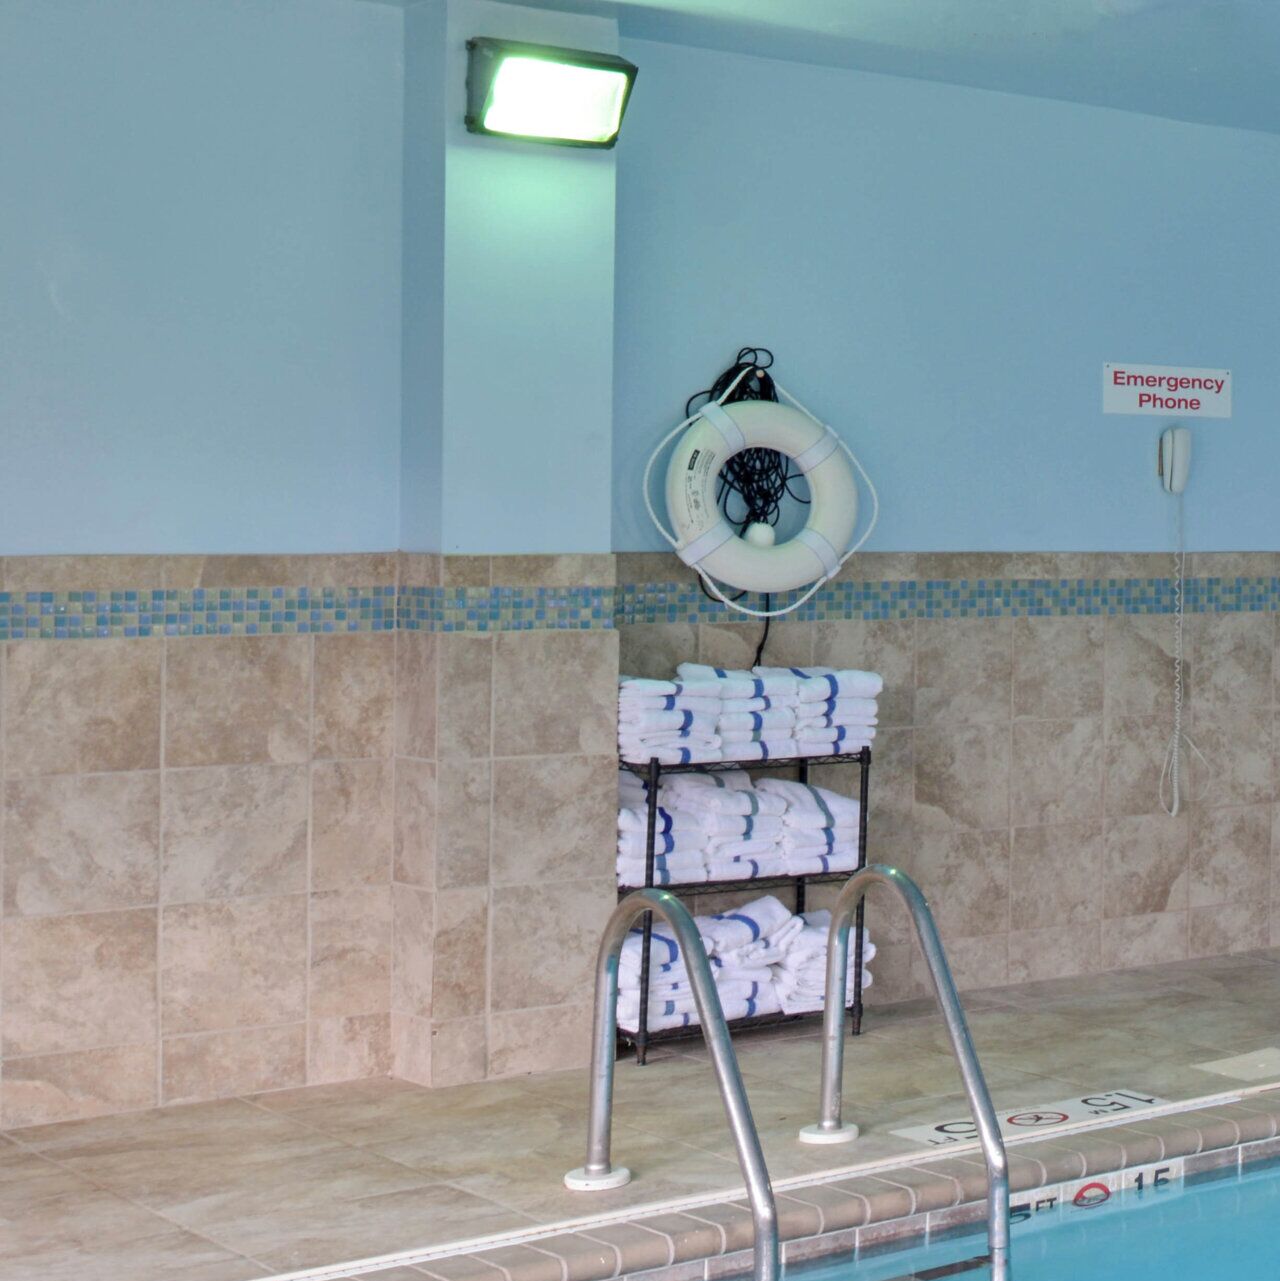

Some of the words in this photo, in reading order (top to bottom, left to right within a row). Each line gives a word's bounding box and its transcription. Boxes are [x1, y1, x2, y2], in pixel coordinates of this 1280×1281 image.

[1112, 370, 1225, 394] Emergency
[1138, 393, 1201, 410] Phone
[1036, 1197, 1058, 1212] FT
